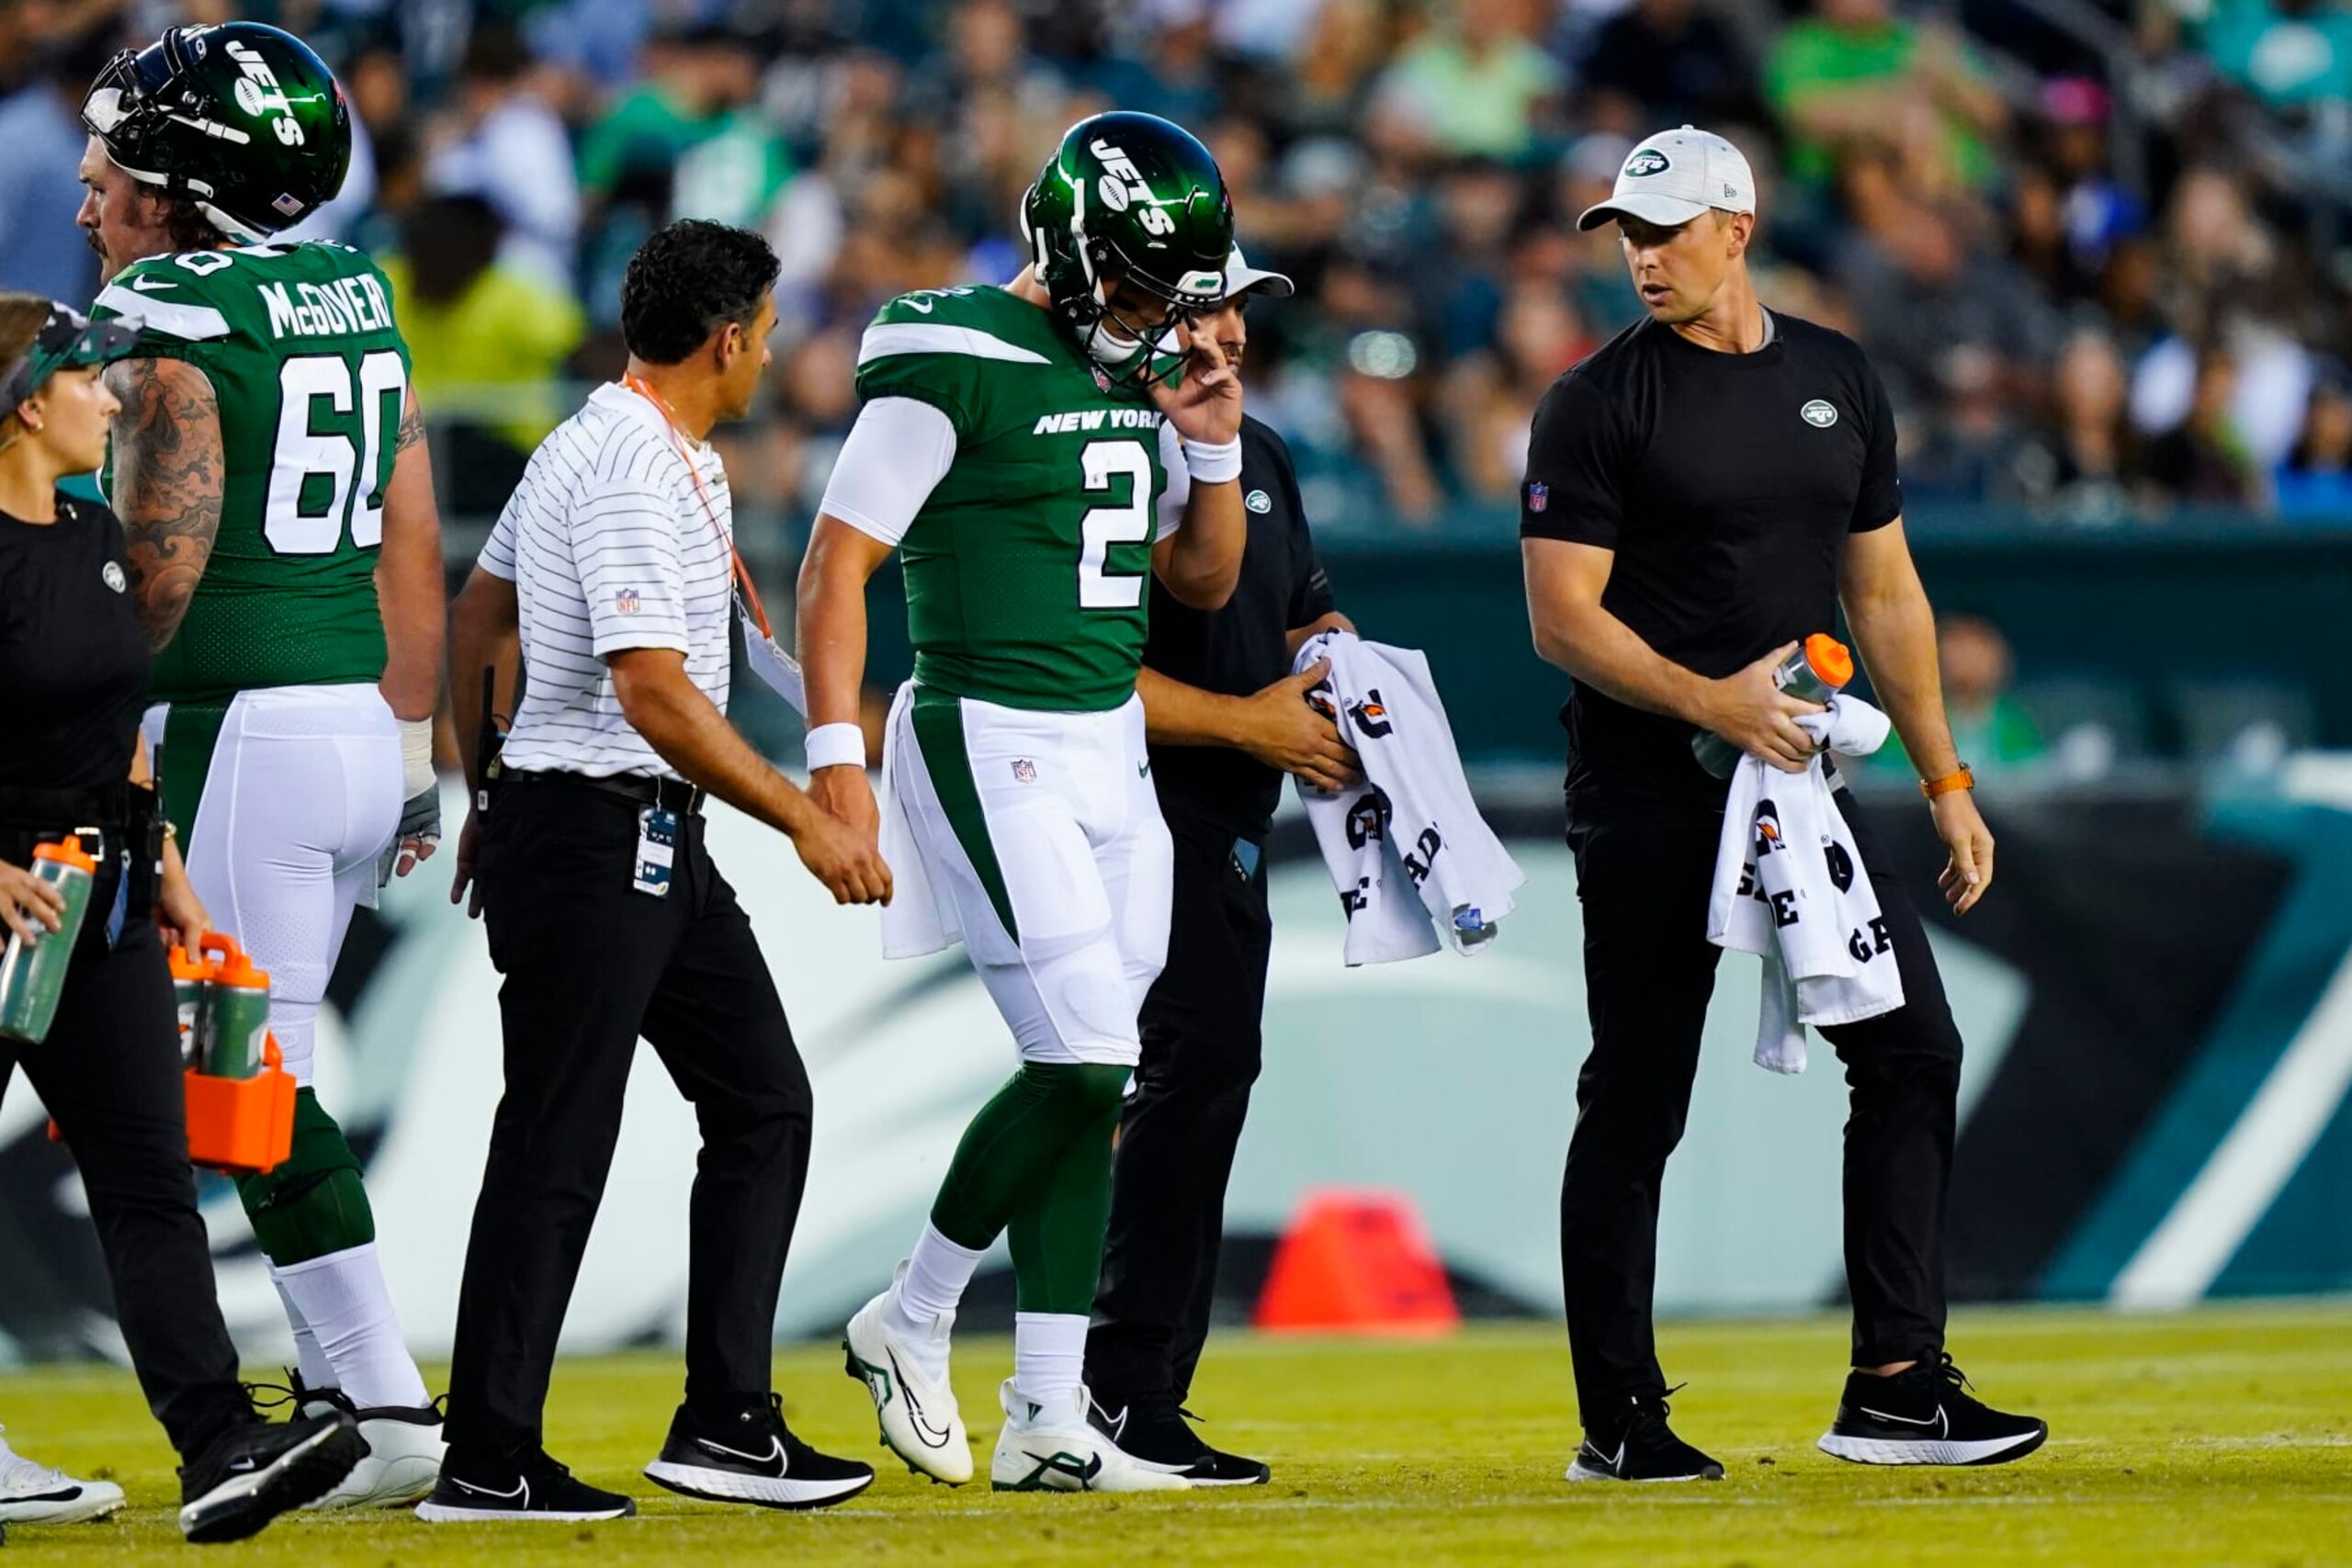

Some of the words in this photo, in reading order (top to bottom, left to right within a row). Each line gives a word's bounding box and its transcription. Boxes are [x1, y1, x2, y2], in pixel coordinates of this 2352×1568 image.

[225, 39, 305, 146] JETS
[1090, 138, 1176, 236] JETS
[264, 347, 407, 556] 60
[1033, 410, 1107, 434] NEW
[1078, 439, 1152, 608] 2
